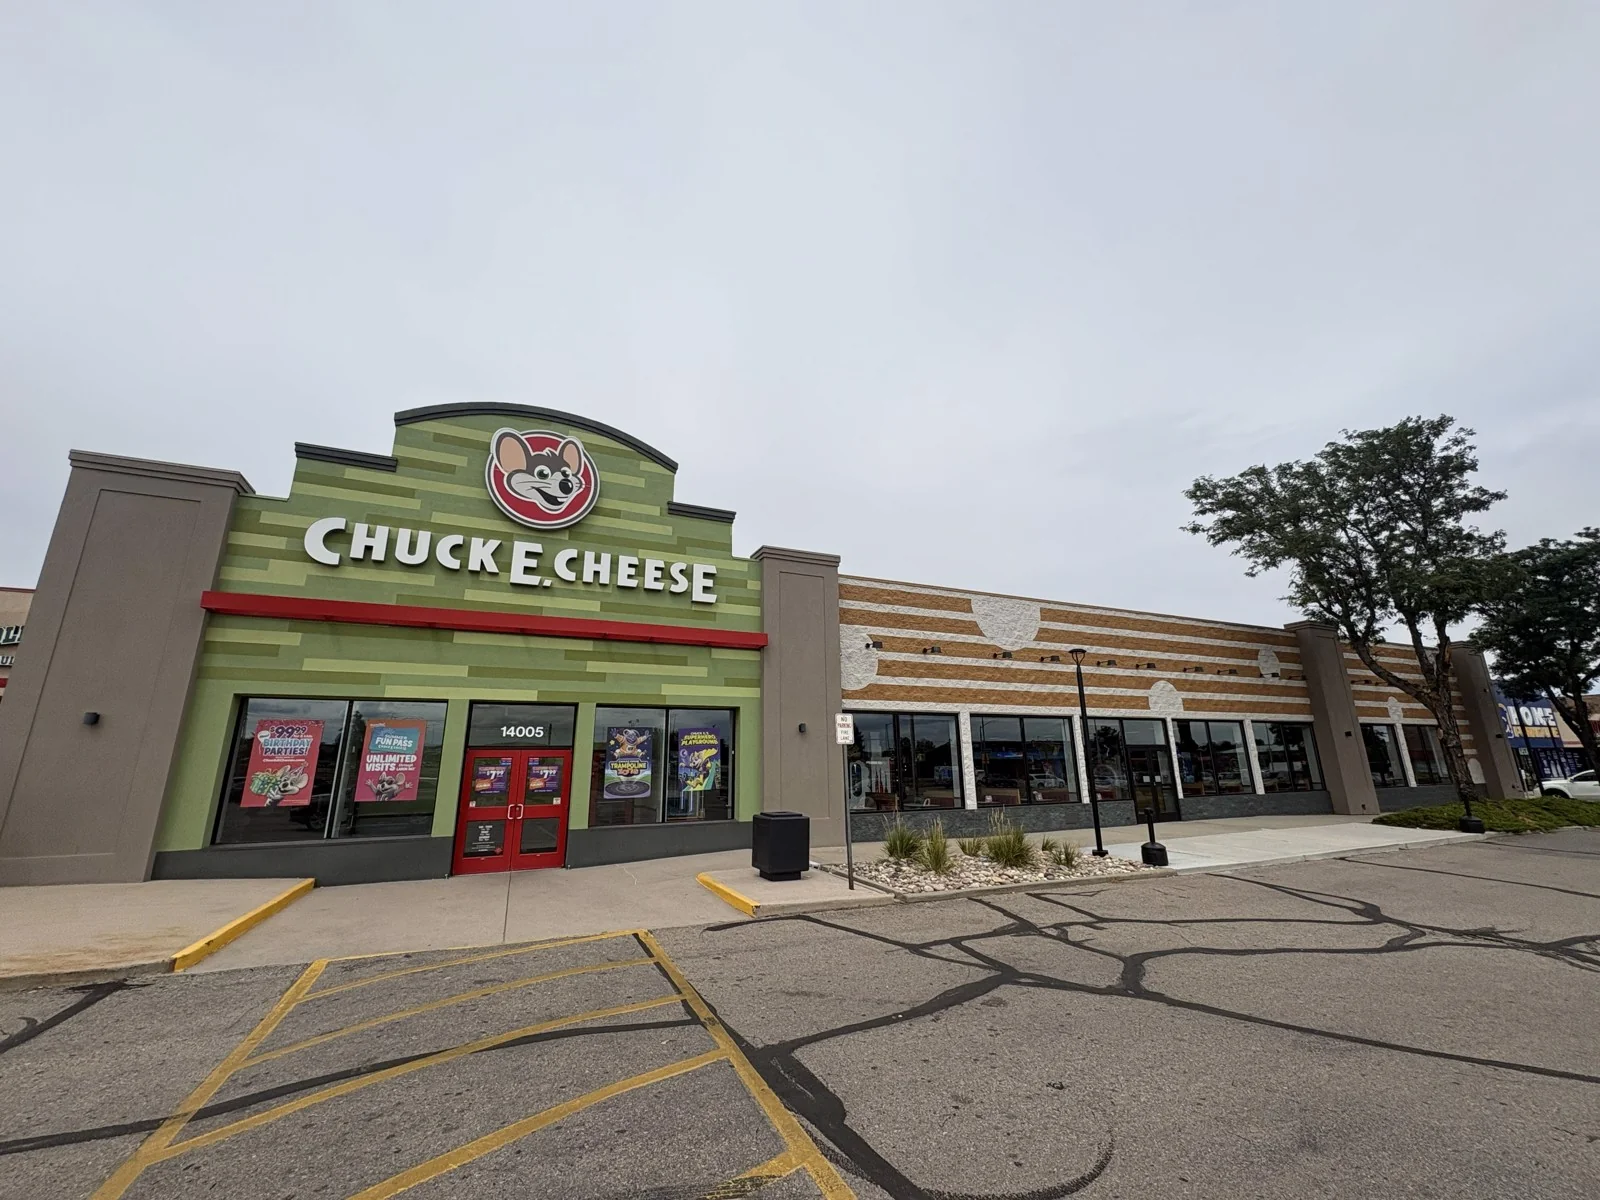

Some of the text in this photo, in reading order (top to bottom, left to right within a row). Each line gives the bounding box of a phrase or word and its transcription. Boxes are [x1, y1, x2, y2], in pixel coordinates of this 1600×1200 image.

[304, 517, 718, 604] CHUCK E. CHEESE
[1507, 706, 1556, 726] HOME
[500, 726, 544, 738] 14005
[263, 738, 312, 747] BIRTHDAY
[375, 737, 393, 745] FUN
[393, 739, 413, 748] PASS
[264, 747, 308, 755] PARTIES!
[366, 754, 417, 763] UNLIMITED
[365, 763, 396, 772] VISITS
